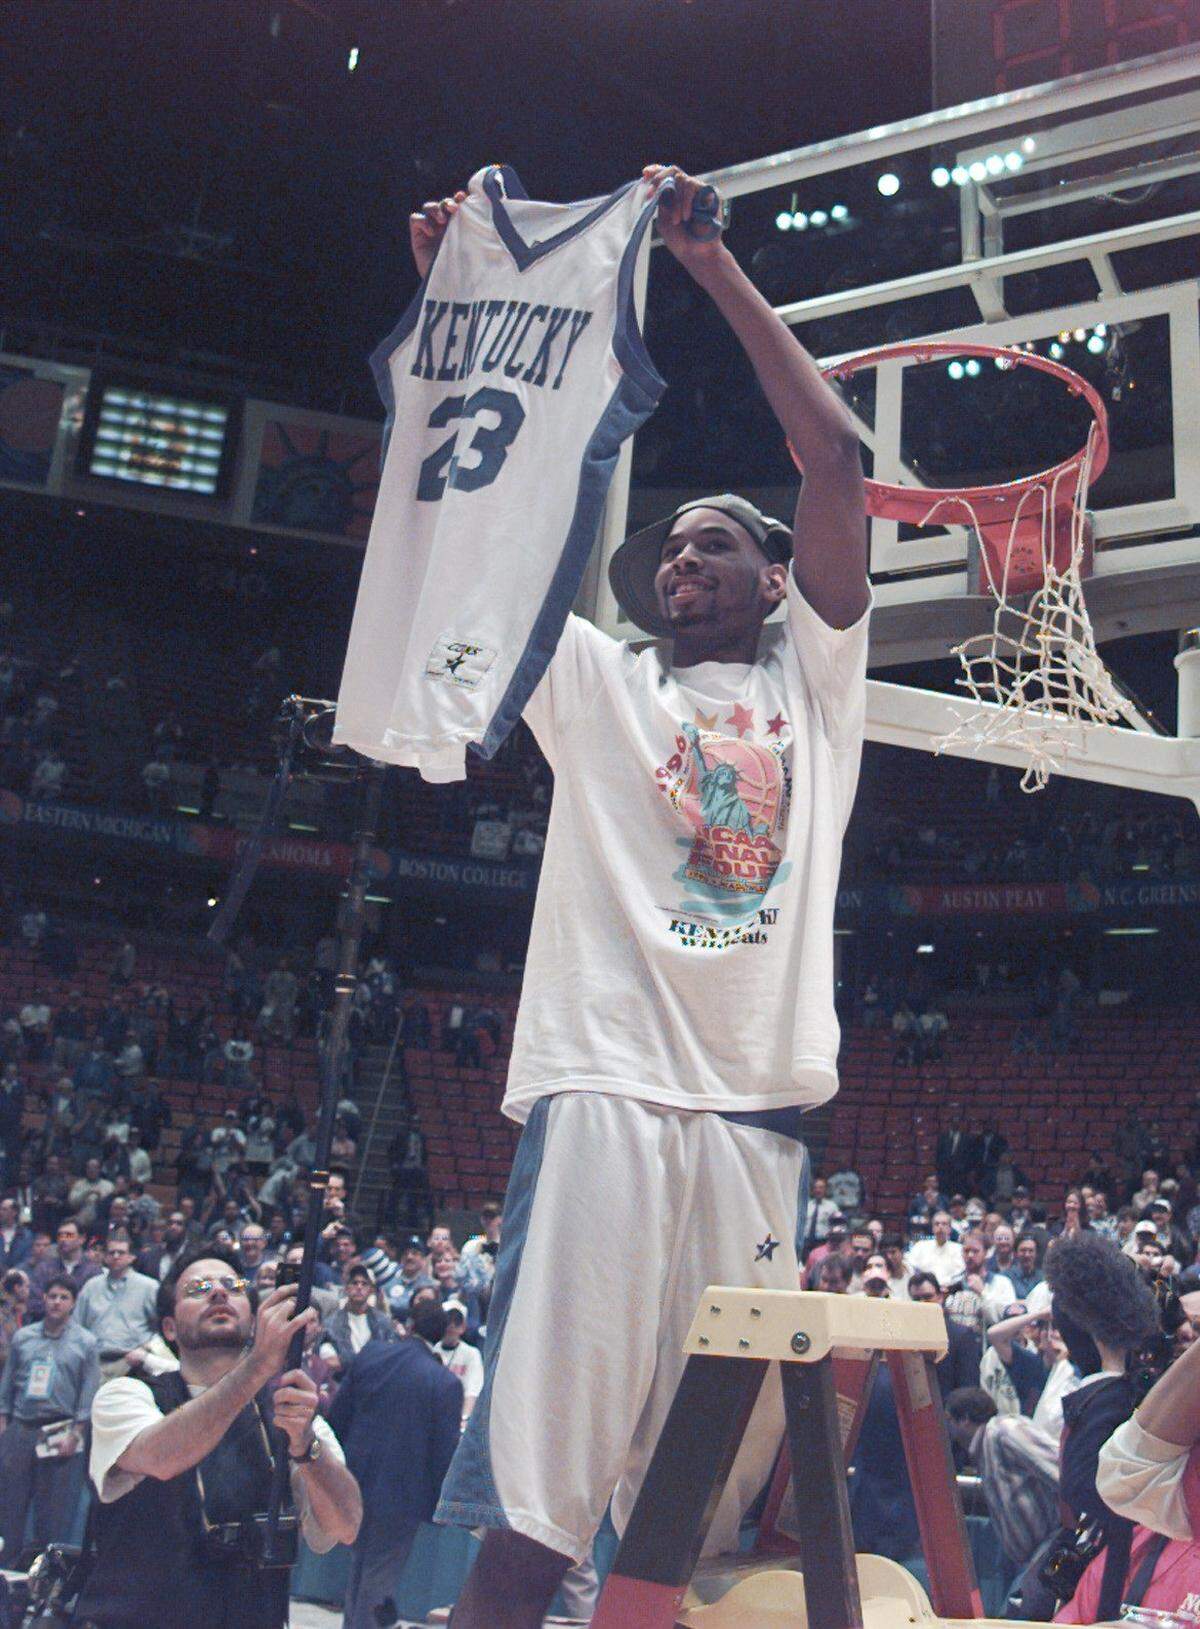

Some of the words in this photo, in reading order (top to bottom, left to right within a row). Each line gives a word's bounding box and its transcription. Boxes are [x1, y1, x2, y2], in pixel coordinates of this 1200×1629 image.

[410, 299, 594, 391] KENTUCKY
[416, 386, 526, 502] 23
[24, 802, 91, 830] EASTERN
[93, 813, 172, 843] MICHIGAN
[398, 857, 459, 882] BOSTON
[461, 865, 529, 889] COLLEGE
[942, 890, 1000, 909] AUSTIN
[1005, 888, 1047, 908] PEAY
